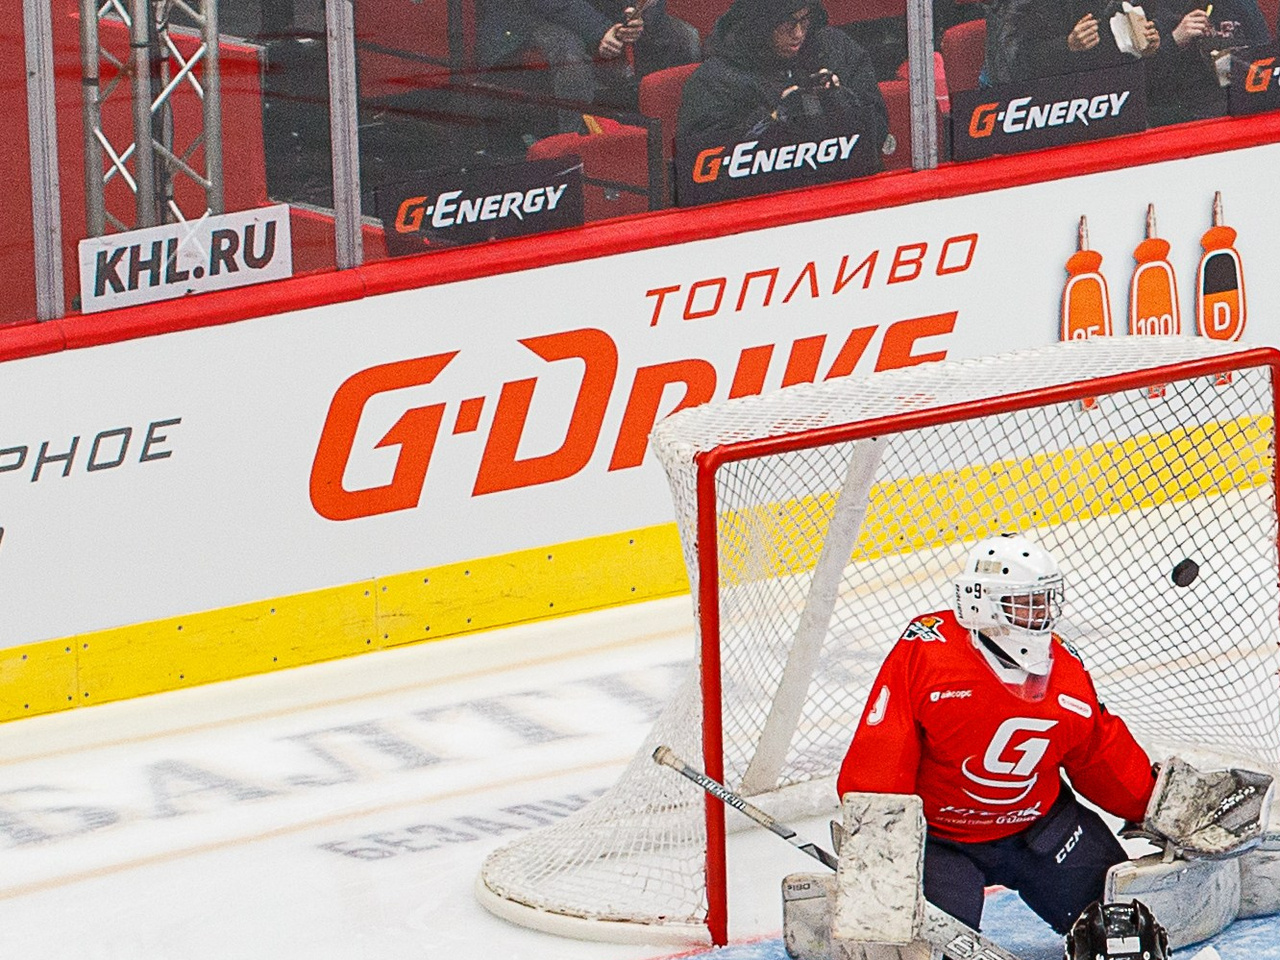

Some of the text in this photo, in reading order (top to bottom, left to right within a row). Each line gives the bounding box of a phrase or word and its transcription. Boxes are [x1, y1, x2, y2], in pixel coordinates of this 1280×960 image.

[94, 220, 278, 297] KHL.RU
[645, 233, 979, 327] ТОПЛИВО
[1213, 301, 1231, 331] D
[1055, 825, 1083, 864] CCM
